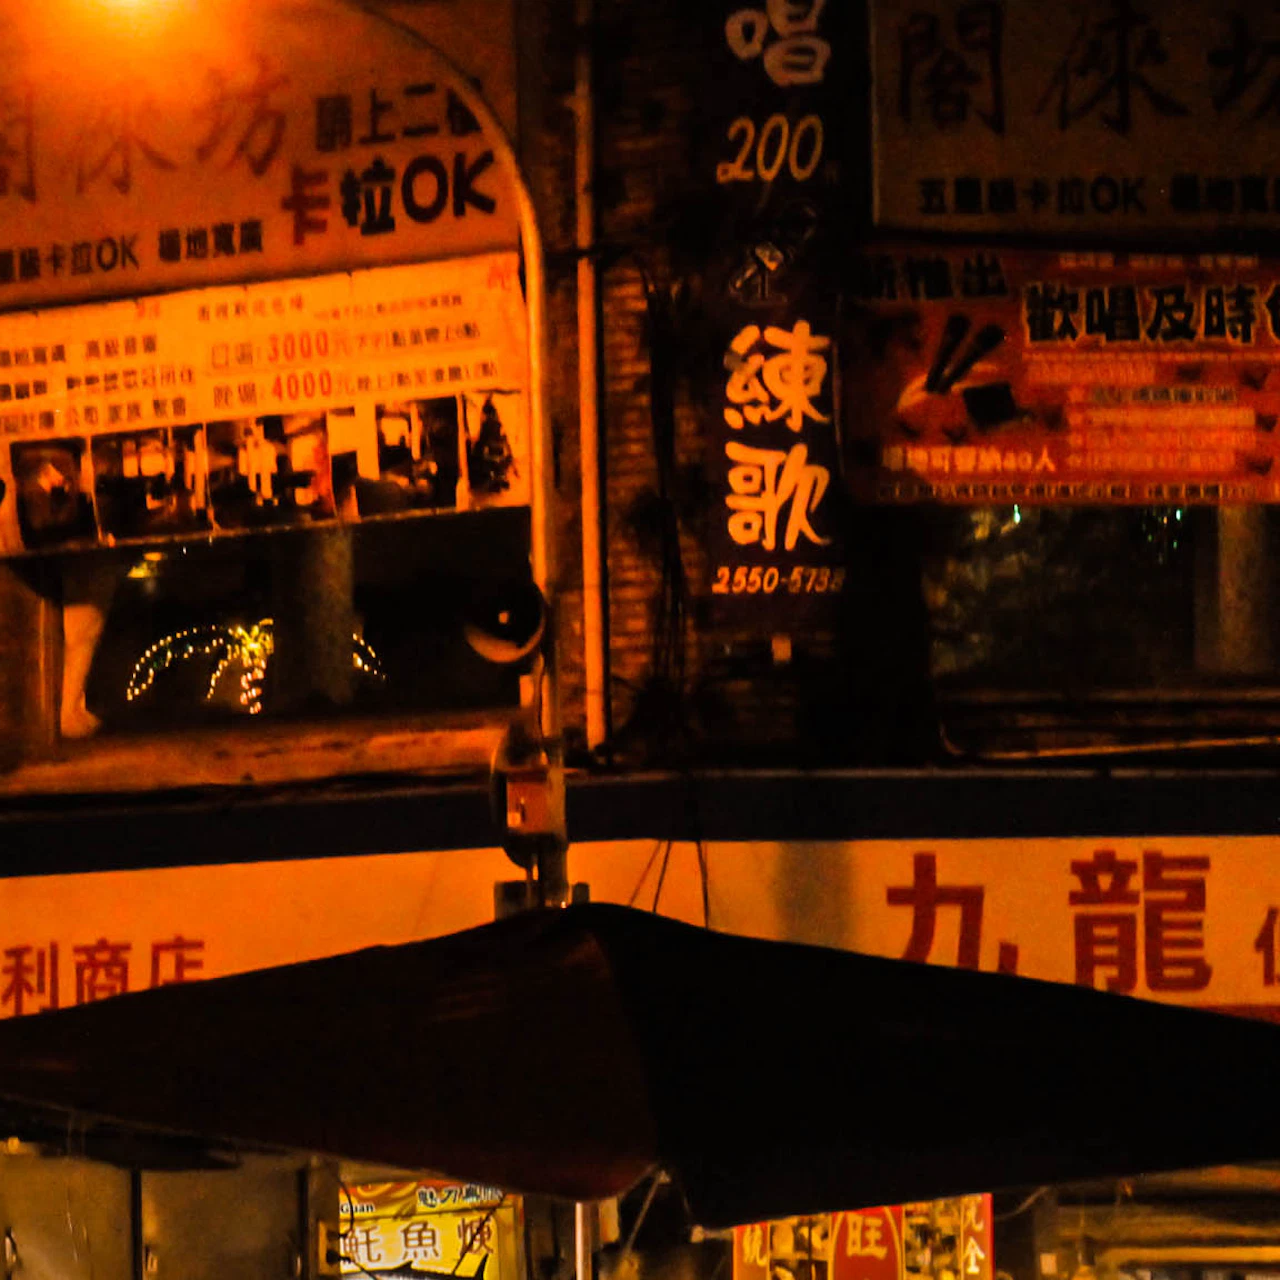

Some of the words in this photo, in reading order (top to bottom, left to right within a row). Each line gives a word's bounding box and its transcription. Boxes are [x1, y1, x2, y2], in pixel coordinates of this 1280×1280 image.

[715, 112, 824, 184] 200
[723, 319, 833, 553] 練歌
[886, 850, 1213, 996] 九龍
